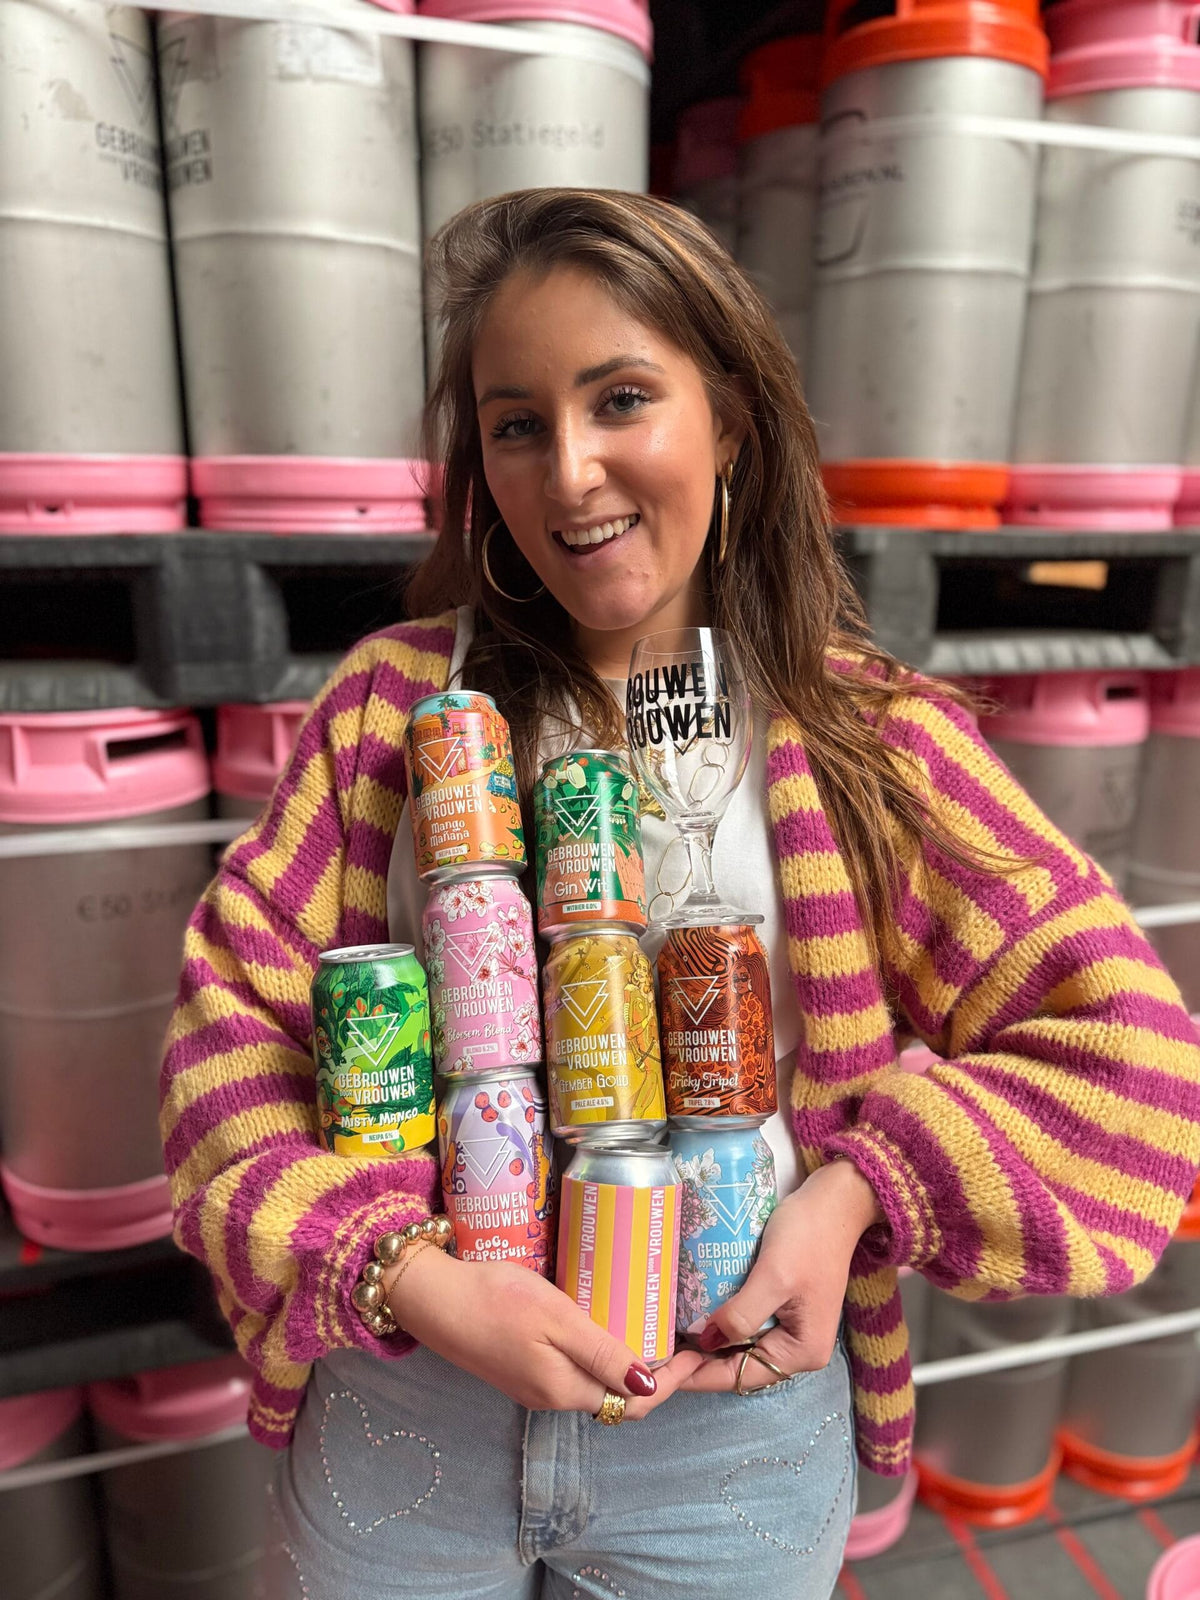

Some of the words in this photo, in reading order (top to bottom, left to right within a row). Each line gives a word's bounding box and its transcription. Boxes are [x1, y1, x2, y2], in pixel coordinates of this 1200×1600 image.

[416, 784, 481, 810] GEBROUWEN
[426, 799, 482, 821] VROUWEN
[431, 820, 466, 835] Mango
[547, 842, 615, 863] GEBROUWEN
[559, 857, 616, 875] VROUWEN
[554, 881, 578, 897] Gin
[579, 876, 609, 893] Wit
[441, 981, 513, 1004] GEBROUWEN
[454, 997, 514, 1018] VROUWEN
[484, 1022, 514, 1039] Blond
[668, 1029, 736, 1047] GEBROUWEN
[556, 1033, 626, 1056] GEBROUWEN
[679, 1045, 737, 1063] VROUWEN
[567, 1050, 627, 1071] VROUWEN
[339, 1064, 414, 1089] GEBROUWEN
[670, 1070, 700, 1092] Tricky
[702, 1071, 739, 1092] Tripel
[354, 1080, 415, 1106] VROUWEN
[455, 1191, 527, 1213] GEBROUWEN
[467, 1208, 529, 1231] VROUWEN
[581, 1185, 598, 1252] VROUWEN
[649, 1189, 665, 1257] VROUWEN
[713, 1258, 752, 1276] VROU
[643, 1273, 660, 1358] GEBROUWEN
